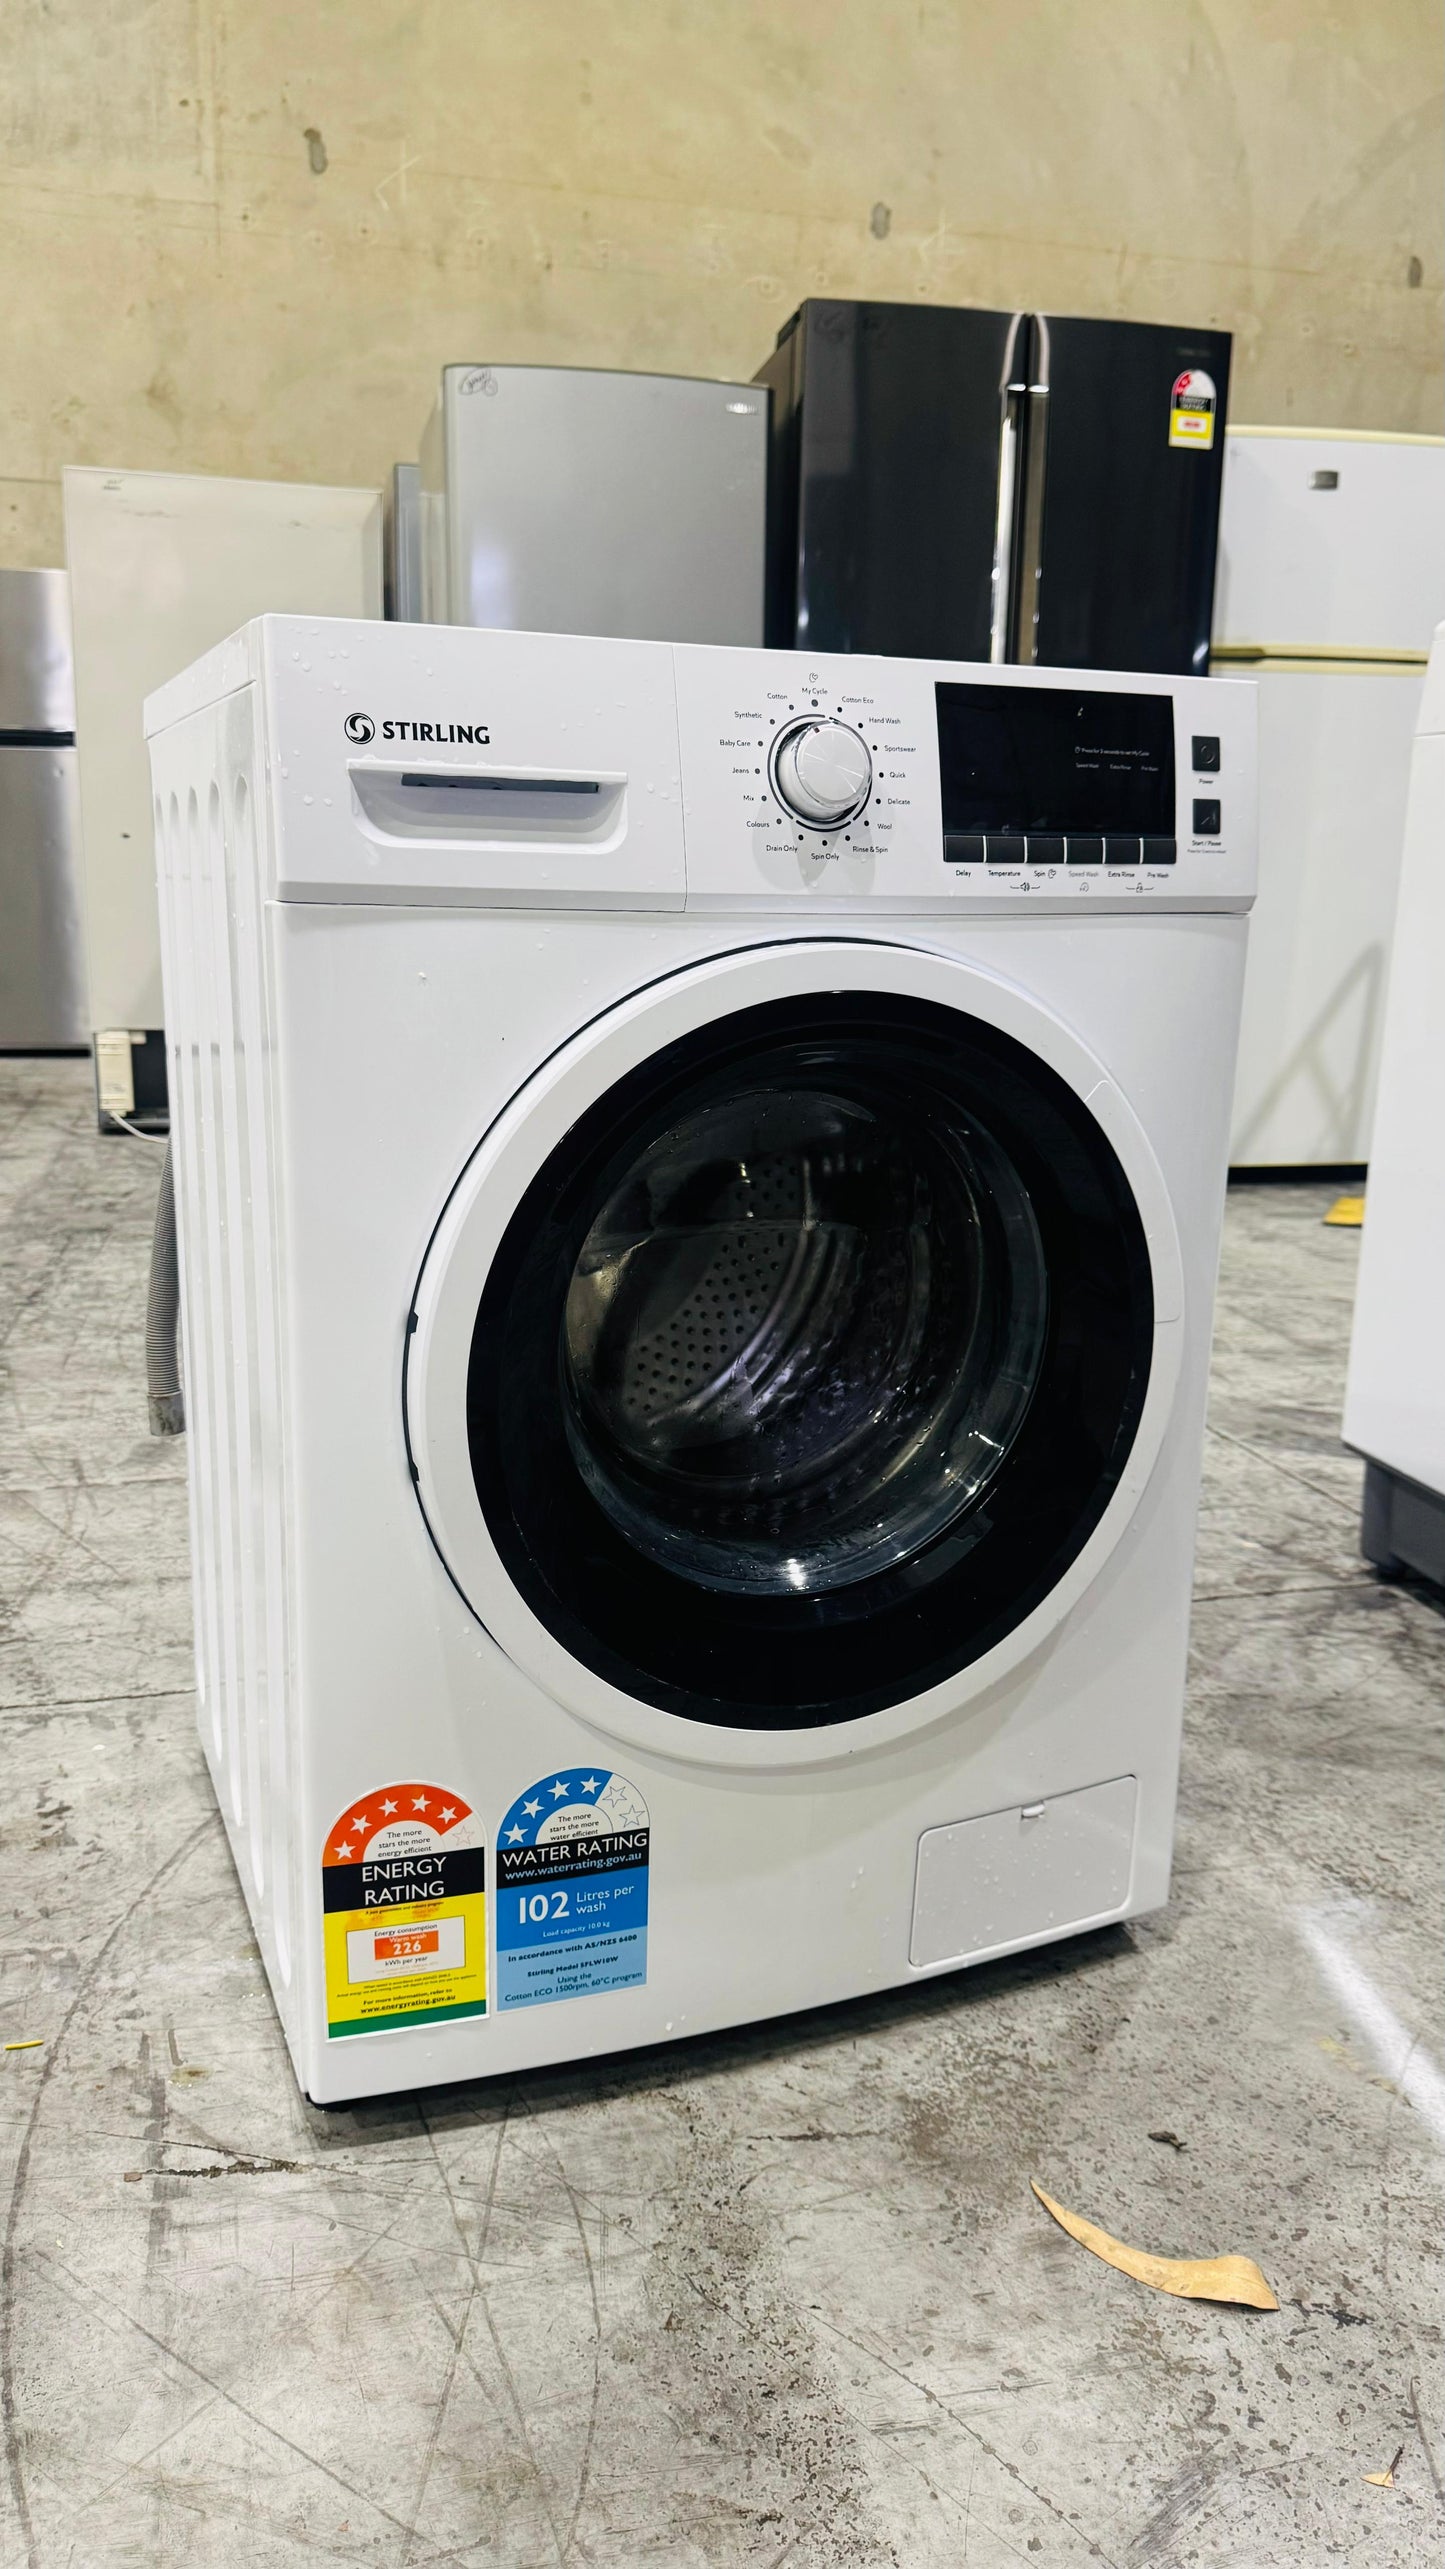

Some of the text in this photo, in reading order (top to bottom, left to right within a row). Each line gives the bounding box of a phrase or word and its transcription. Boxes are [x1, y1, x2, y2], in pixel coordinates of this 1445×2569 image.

[767, 692, 788, 700] Cotton
[734, 711, 763, 719] Synthetic
[382, 721, 491, 745] STIRLING
[720, 739, 735, 747] Baby
[884, 745, 917, 753] Sportswear
[784, 845, 798, 853] Only
[811, 853, 840, 861] Spin Only
[572, 1813, 592, 1821] more
[549, 1825, 566, 1833] stars
[549, 1829, 598, 1841] water efficient
[397, 1839, 410, 1847] the
[411, 1837, 431, 1845] more
[403, 1846, 432, 1855] efficient
[502, 1832, 648, 1867] WATER RATING
[362, 1856, 447, 1882] ENERGY
[505, 1852, 642, 1880] www.waterrating.gov.au
[365, 1880, 445, 1905] RATING
[519, 1885, 634, 1924] 102 Litres per
[576, 1900, 606, 1915] wash
[397, 1924, 438, 1934] consumption
[560, 1926, 586, 1936] capacity
[588, 1922, 601, 1930] 10.0
[393, 1940, 422, 1956] 226
[518, 1949, 563, 1961] accordance
[564, 1944, 583, 1953] with
[584, 1938, 617, 1950] AS/NZS
[618, 1934, 638, 1943] 6400
[527, 1968, 554, 1977] Stirling
[555, 1963, 579, 1973] Model
[557, 1972, 592, 1984] Using the
[505, 1992, 533, 2002] Cotton
[534, 1987, 553, 1997] ECO
[611, 1971, 643, 1984] program
[393, 1991, 429, 2001] information,
[360, 1995, 456, 2014] www.energyrating.gov.au
